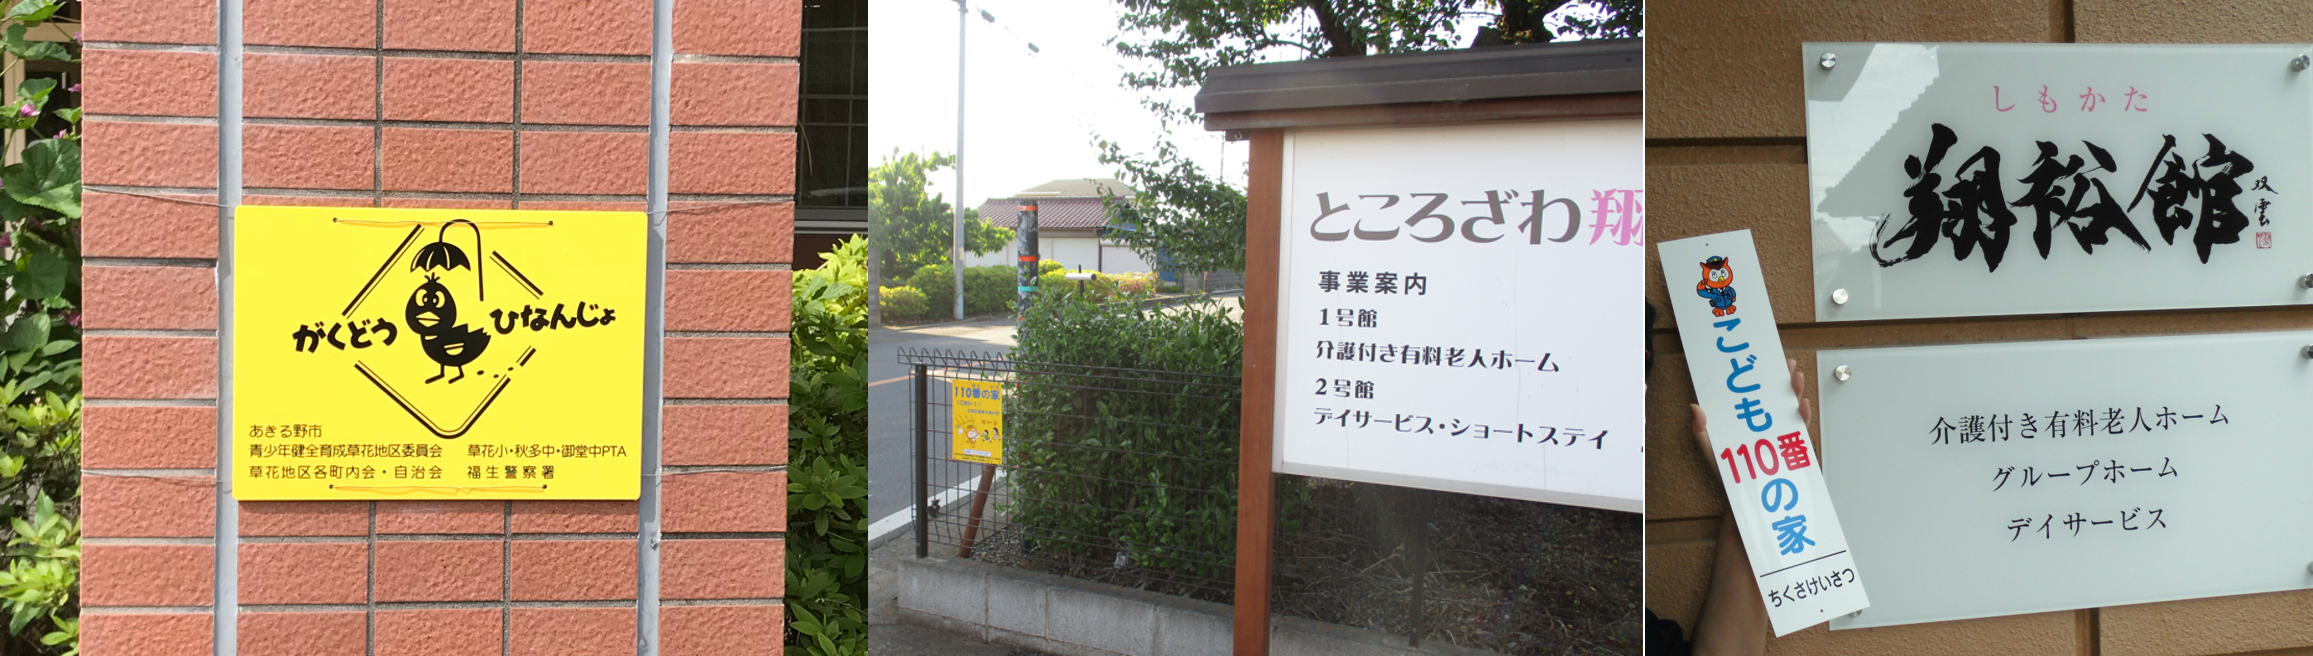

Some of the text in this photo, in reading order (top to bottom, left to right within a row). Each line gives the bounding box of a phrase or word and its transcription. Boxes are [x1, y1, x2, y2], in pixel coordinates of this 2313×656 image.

[1992, 84, 2148, 114] しもかた
[1870, 122, 2254, 273] 翔裕館
[1318, 269, 1427, 296] 事業案内
[292, 301, 617, 354] がくどう ひなんじょ
[1315, 340, 1561, 373] 介護付き有料老人ホーム
[954, 386, 1000, 401] 110番の家
[249, 424, 322, 438] あきる野市
[1313, 407, 1609, 450] デイサービス・ショートステイ
[1929, 404, 2230, 446] 介護付き有料老人ホーム
[250, 444, 443, 458] 青少年健全育成草花地区委員会
[249, 465, 443, 480] 草花地区各町内会・自治会
[467, 465, 555, 479] 福生警察署
[1992, 456, 2178, 492] グループホーム
[2007, 506, 2167, 542] デイサービス
[1768, 568, 1855, 608] ちくさけいさつ
